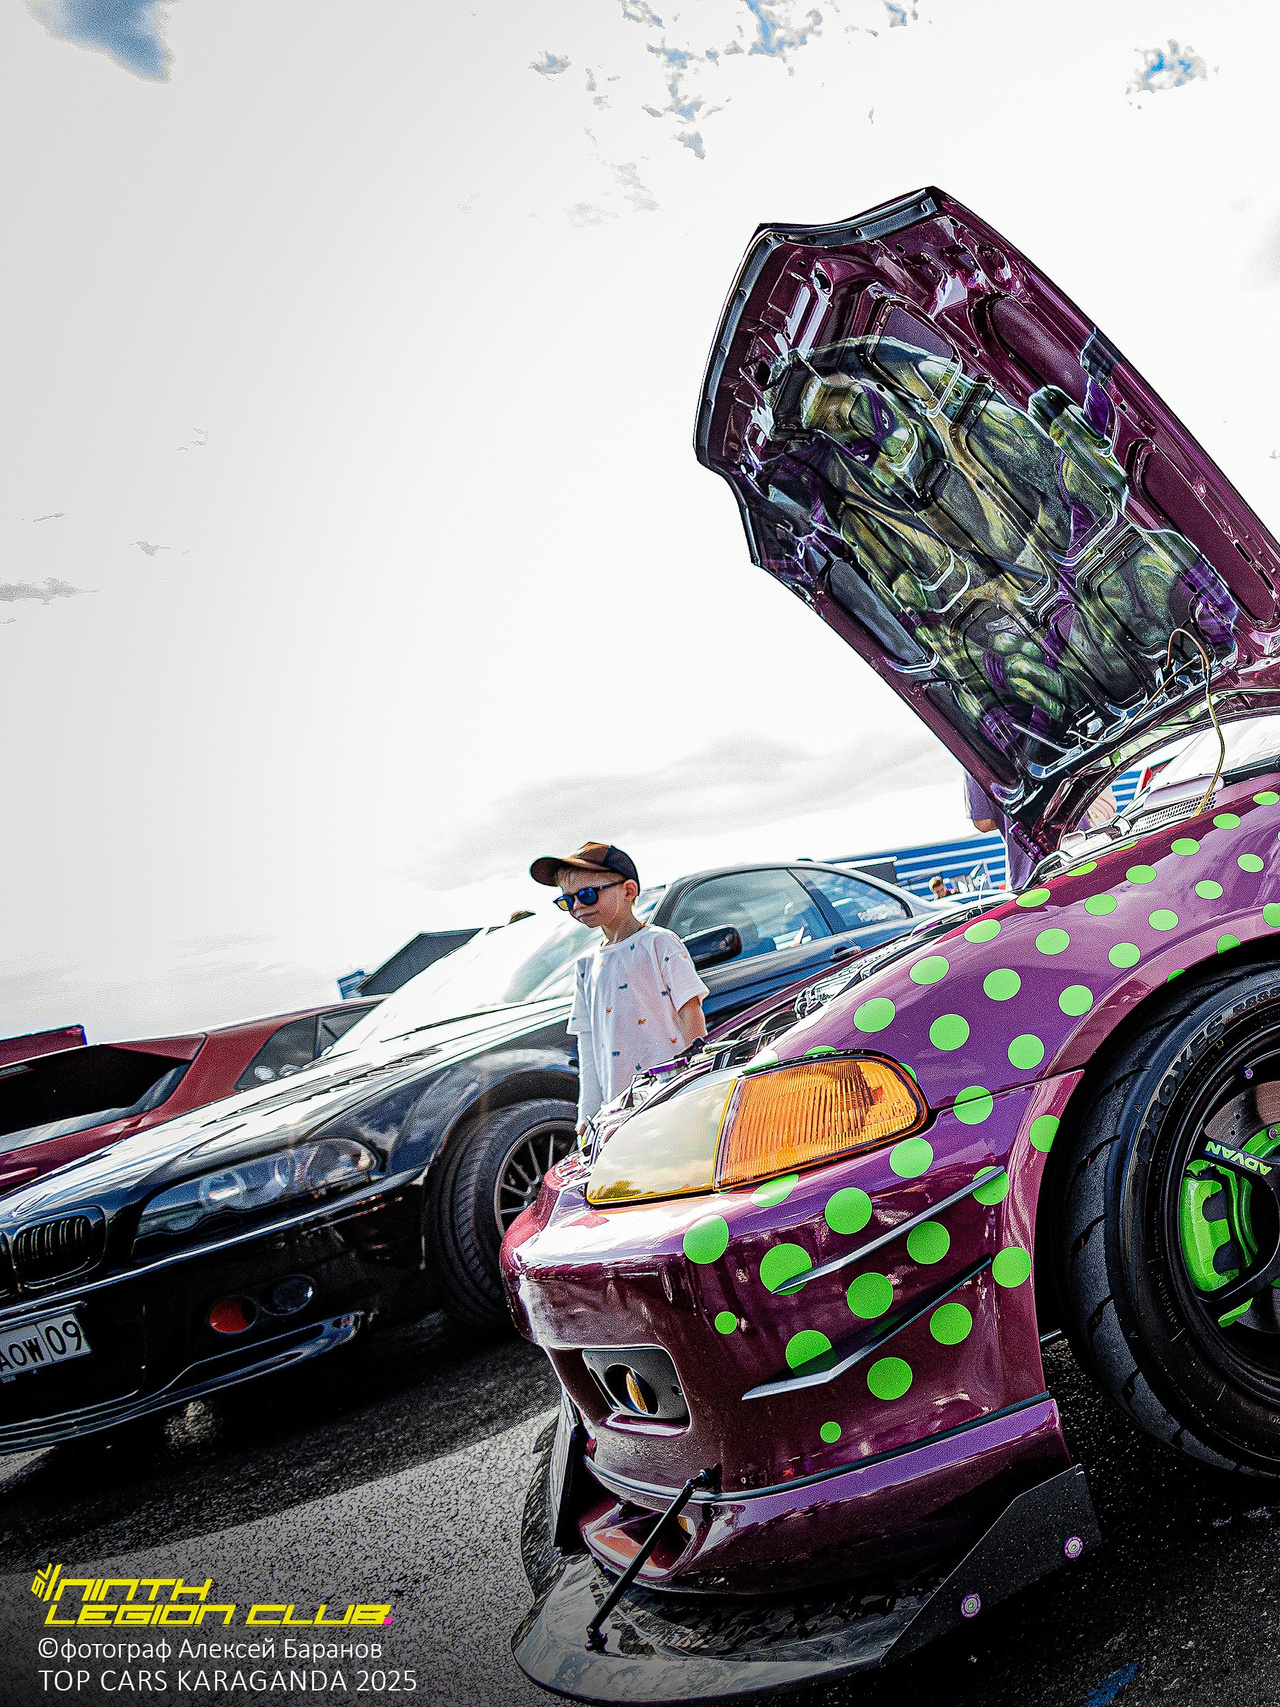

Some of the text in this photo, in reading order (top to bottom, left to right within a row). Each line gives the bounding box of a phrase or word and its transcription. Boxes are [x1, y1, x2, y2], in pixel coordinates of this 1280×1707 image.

[1134, 1013, 1226, 1166] PROXES
[1205, 1140, 1273, 1176] ADVAN
[45, 1320, 82, 1356] 09
